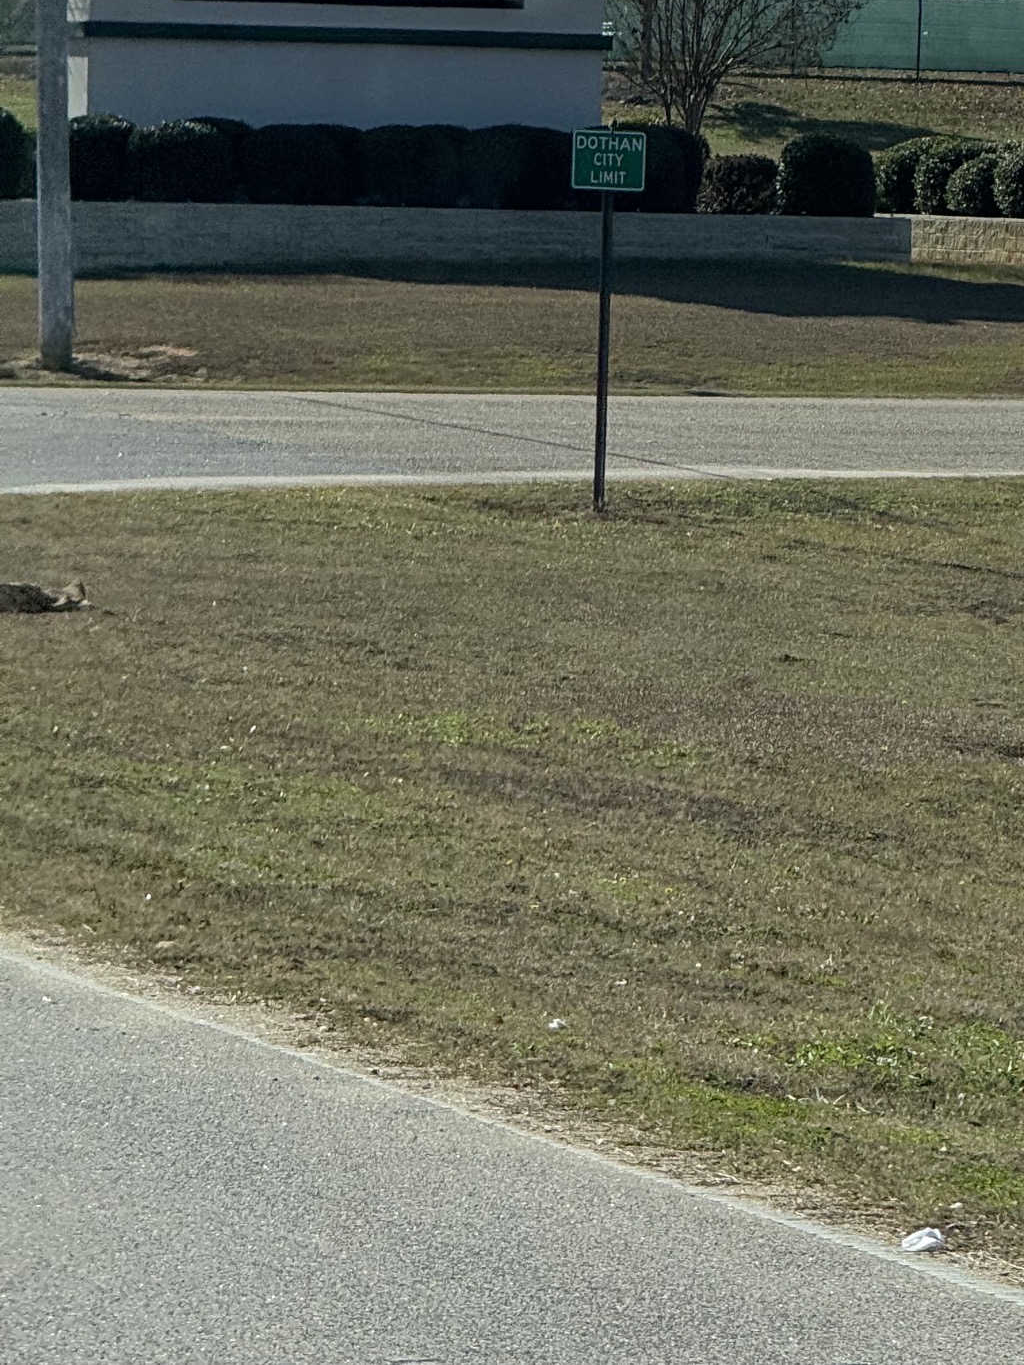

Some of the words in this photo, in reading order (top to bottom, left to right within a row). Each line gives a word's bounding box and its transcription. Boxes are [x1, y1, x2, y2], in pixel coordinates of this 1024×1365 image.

[576, 135, 642, 151] DOTHAN
[593, 152, 624, 167] CITY
[590, 170, 626, 184] LIMIT
